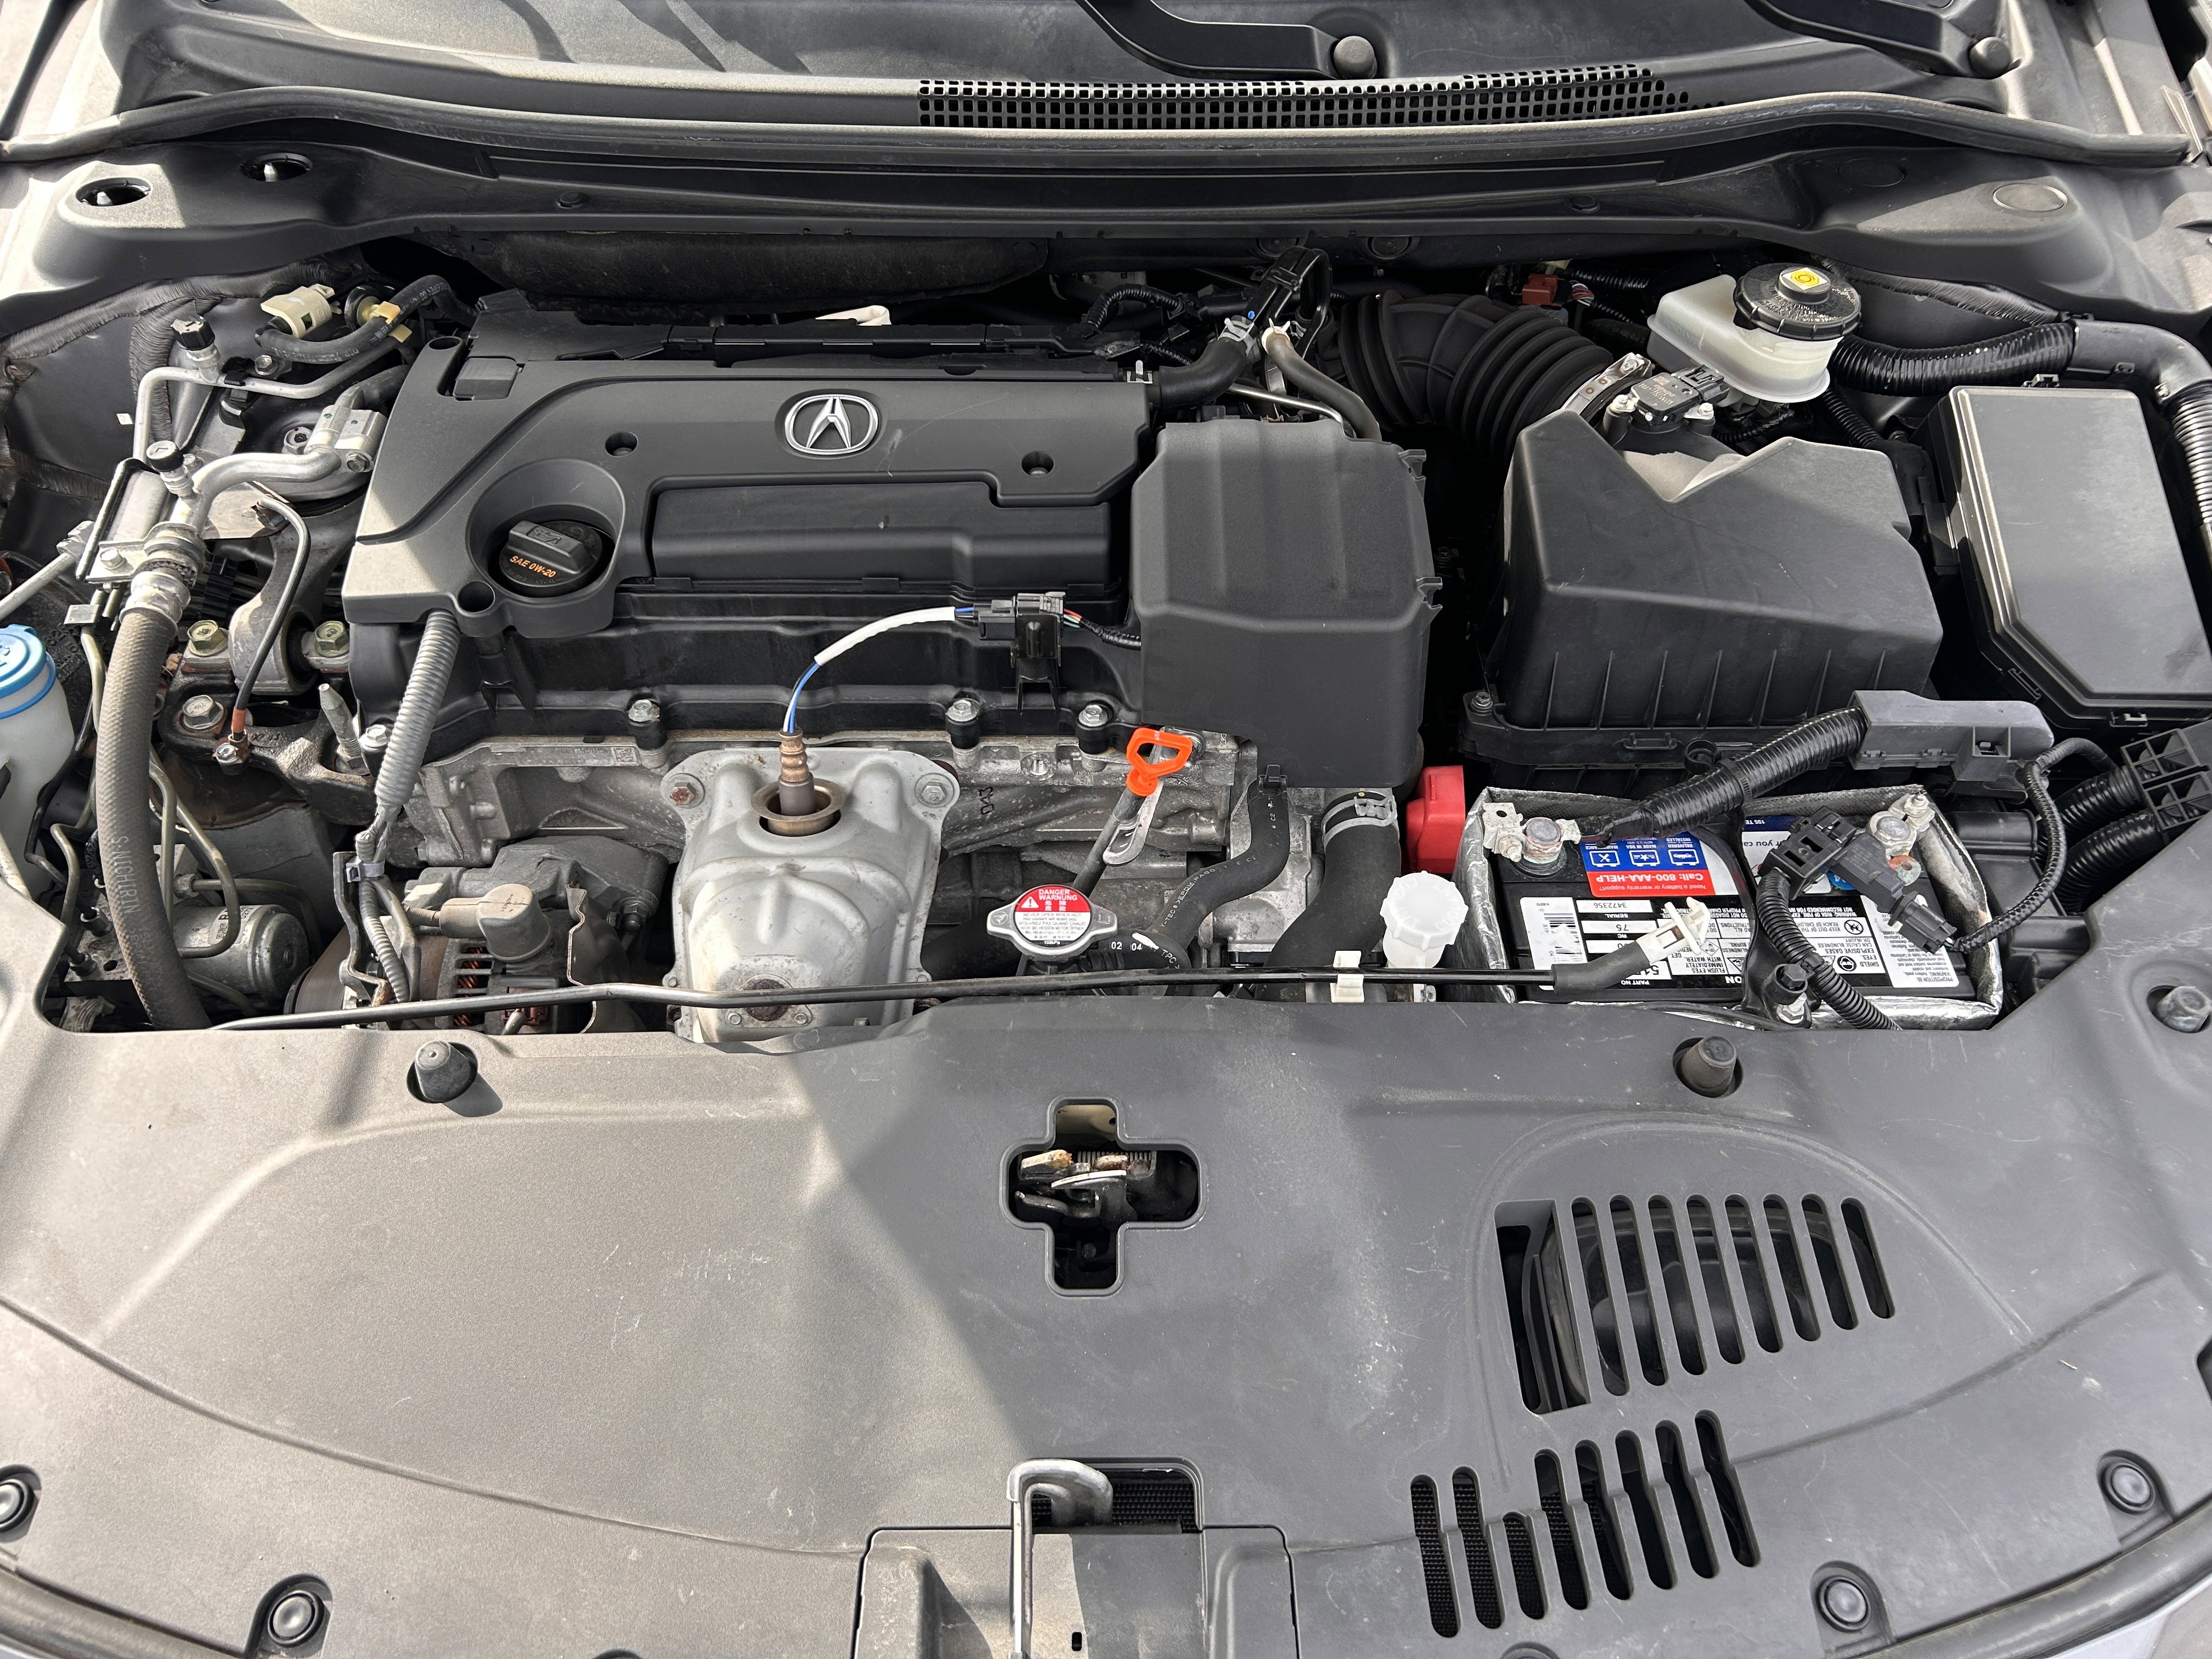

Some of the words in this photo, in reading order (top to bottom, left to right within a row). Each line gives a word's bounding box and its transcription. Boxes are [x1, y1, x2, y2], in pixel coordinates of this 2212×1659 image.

[510, 555, 531, 567] SAE
[529, 563, 557, 577] 0W-20
[1596, 873, 1676, 882] 800-AAA-HELP
[1679, 873, 1703, 882] Call:
[1111, 941, 1122, 950] 02
